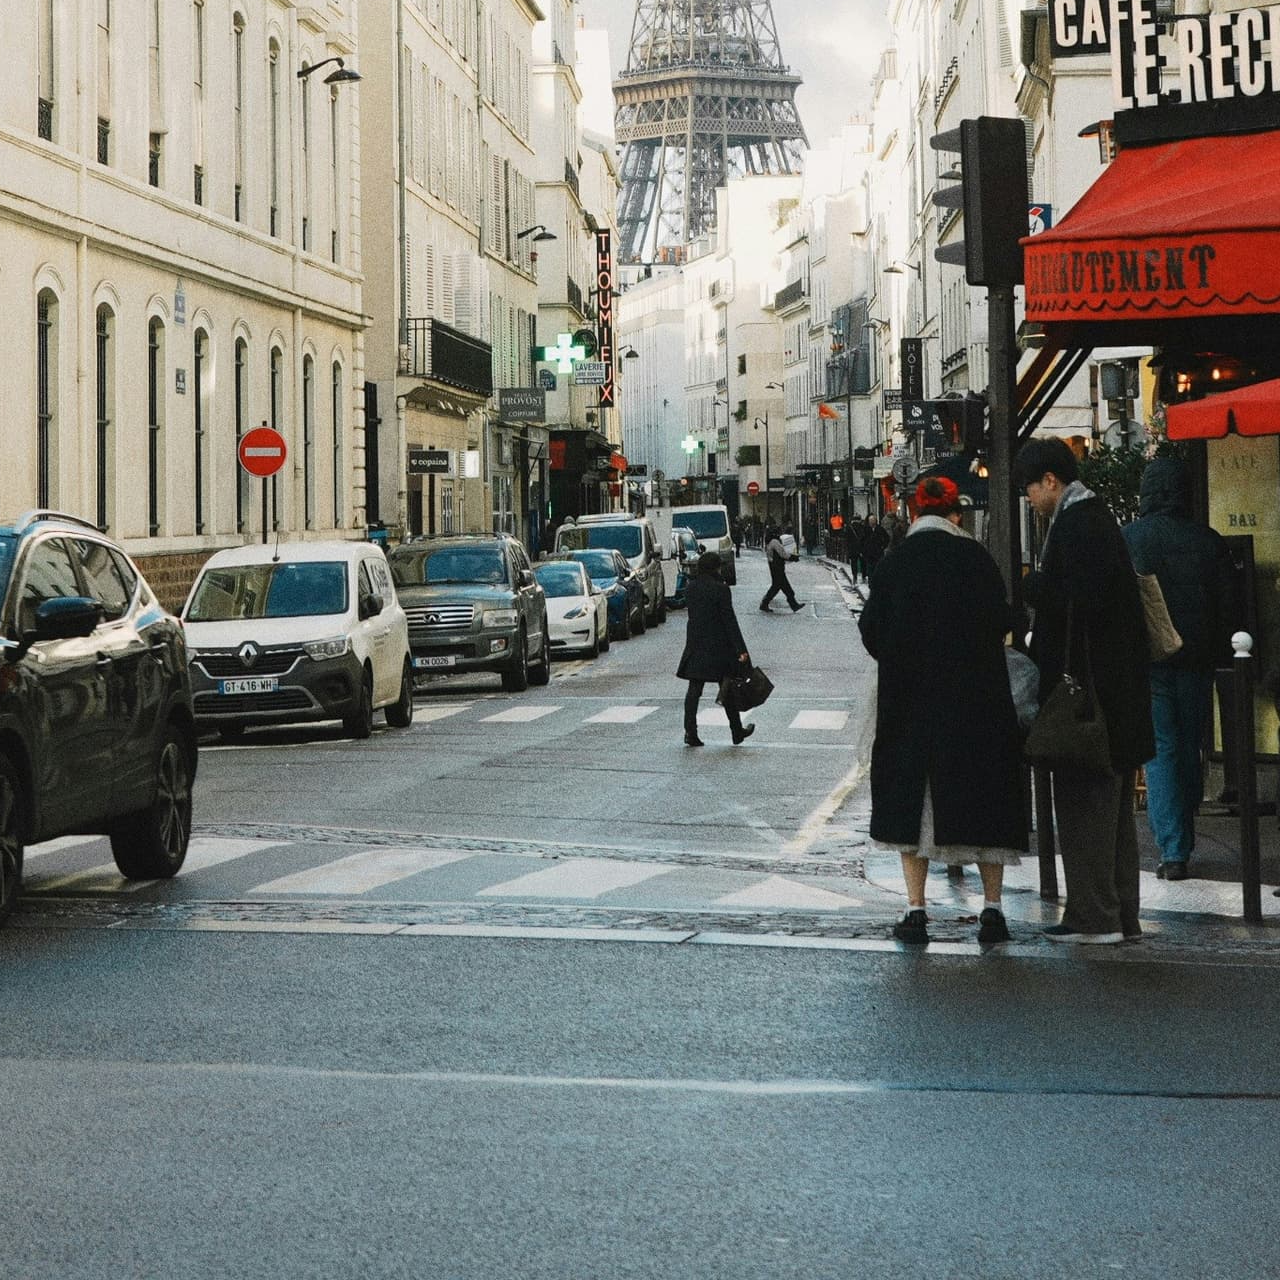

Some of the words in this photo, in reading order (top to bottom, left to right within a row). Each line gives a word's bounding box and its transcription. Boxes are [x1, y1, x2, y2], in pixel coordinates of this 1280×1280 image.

[1109, 23, 1160, 111] LE
[597, 232, 613, 403] THOUMIEUX
[575, 362, 603, 371] LAVERIE
[501, 396, 543, 406] PROVOST
